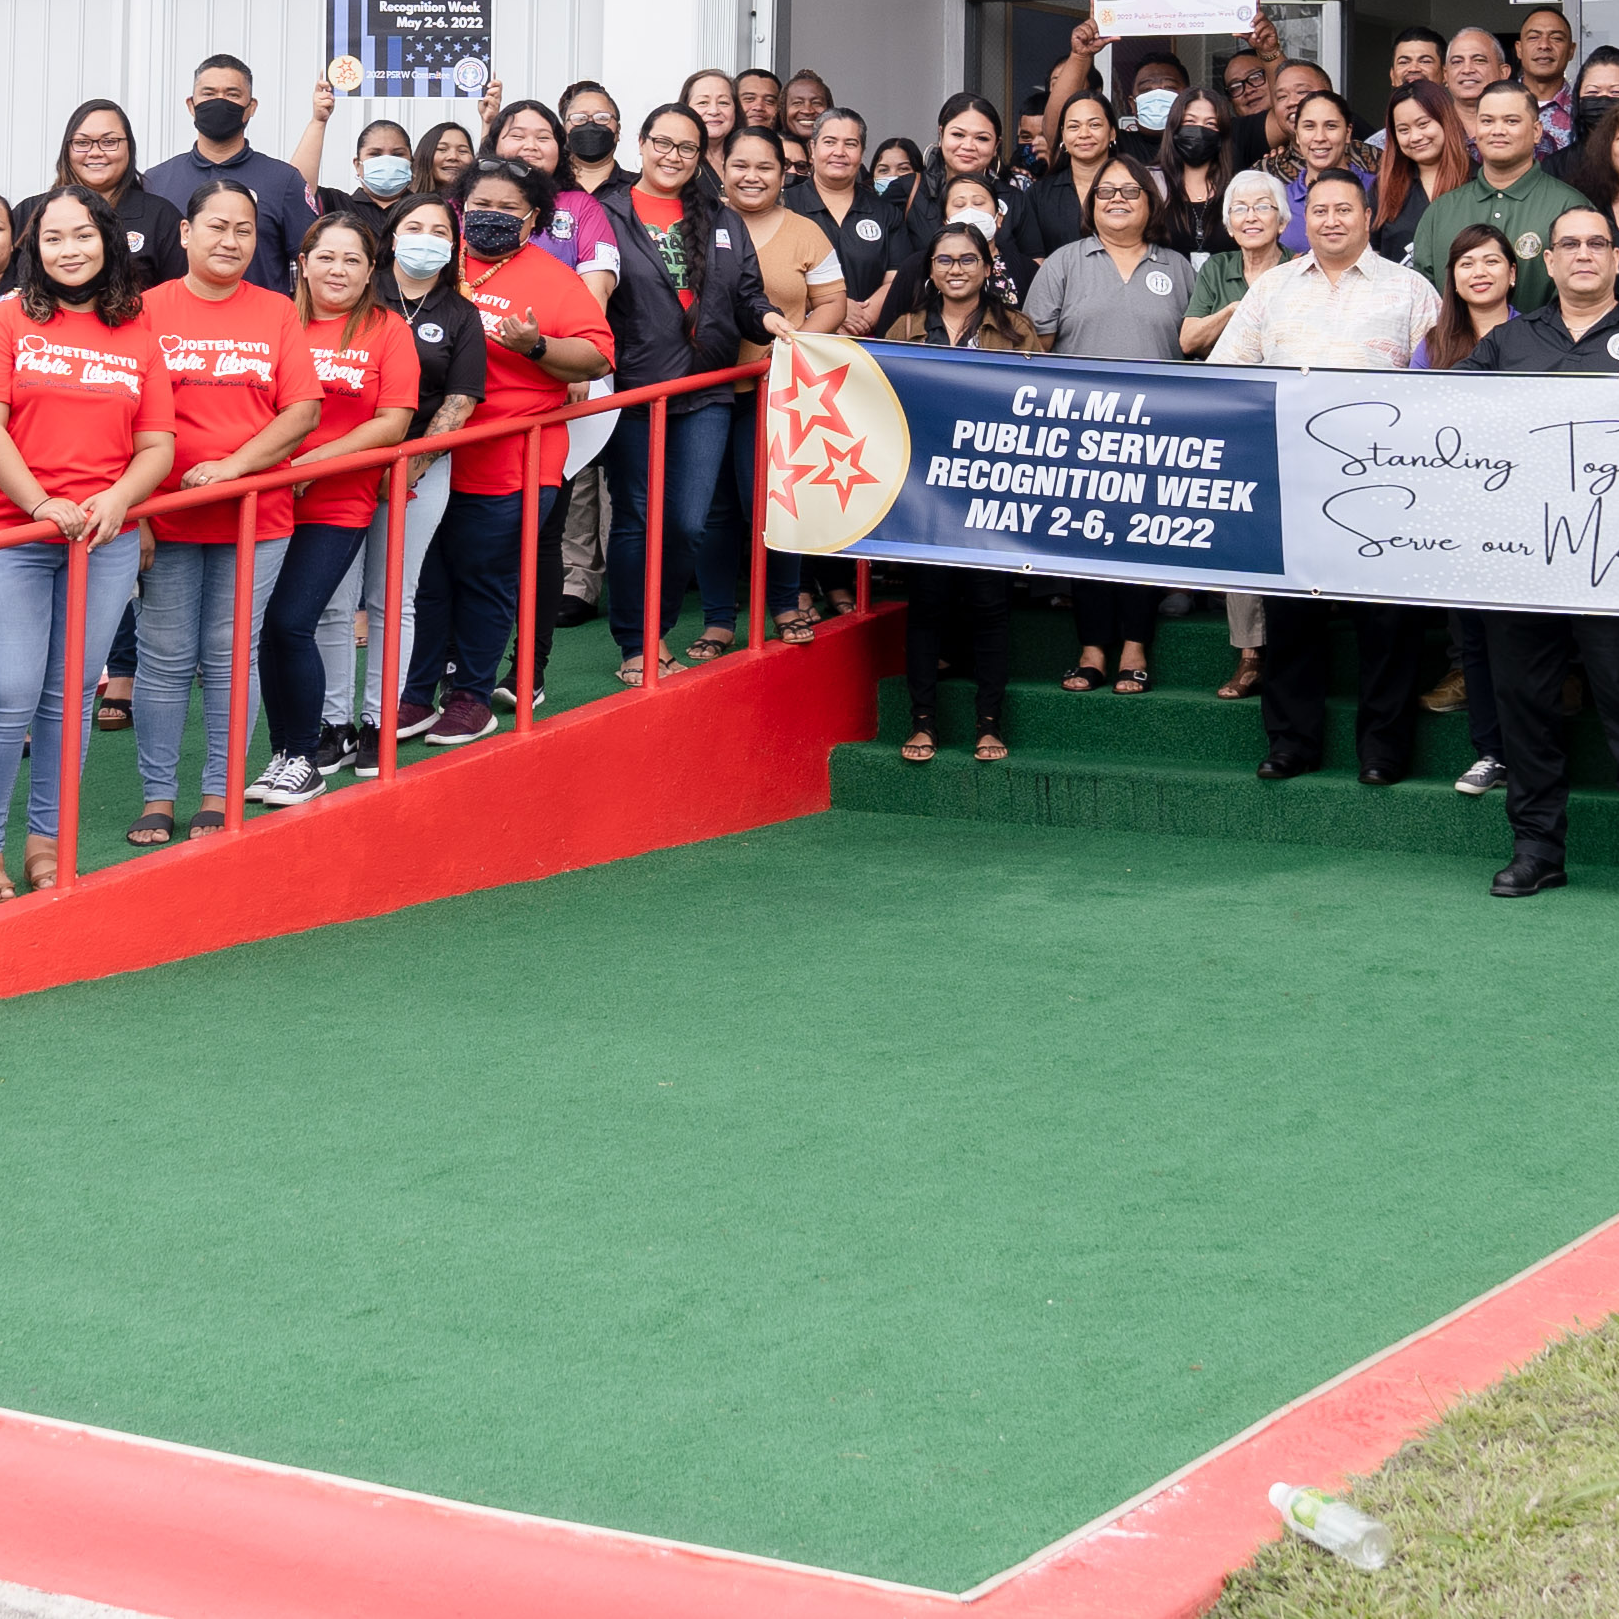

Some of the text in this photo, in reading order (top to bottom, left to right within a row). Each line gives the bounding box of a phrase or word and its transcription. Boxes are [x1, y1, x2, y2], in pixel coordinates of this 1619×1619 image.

[379, 0, 481, 15] Recognition Week
[396, 16, 423, 31] May
[450, 16, 484, 29] 2022
[366, 70, 386, 80] 2022
[386, 70, 411, 80] PSRW
[44, 343, 138, 369] JOETEN-KIYU
[180, 339, 270, 355] JOETEN-KIYU
[16, 351, 73, 376] Public
[80, 361, 141, 395] Library
[164, 351, 273, 382] ublic Library
[313, 358, 366, 390] ibrary
[1011, 385, 1151, 425] C.N.M.I.
[952, 419, 1225, 471] PUBLIC SERVICE
[1305, 401, 1519, 491] Standing
[925, 455, 1258, 513] RECOGNITION WEEK
[964, 498, 1215, 549] MAY 2-6, 2022
[1322, 484, 1462, 557] Serve
[1482, 536, 1535, 557] our
